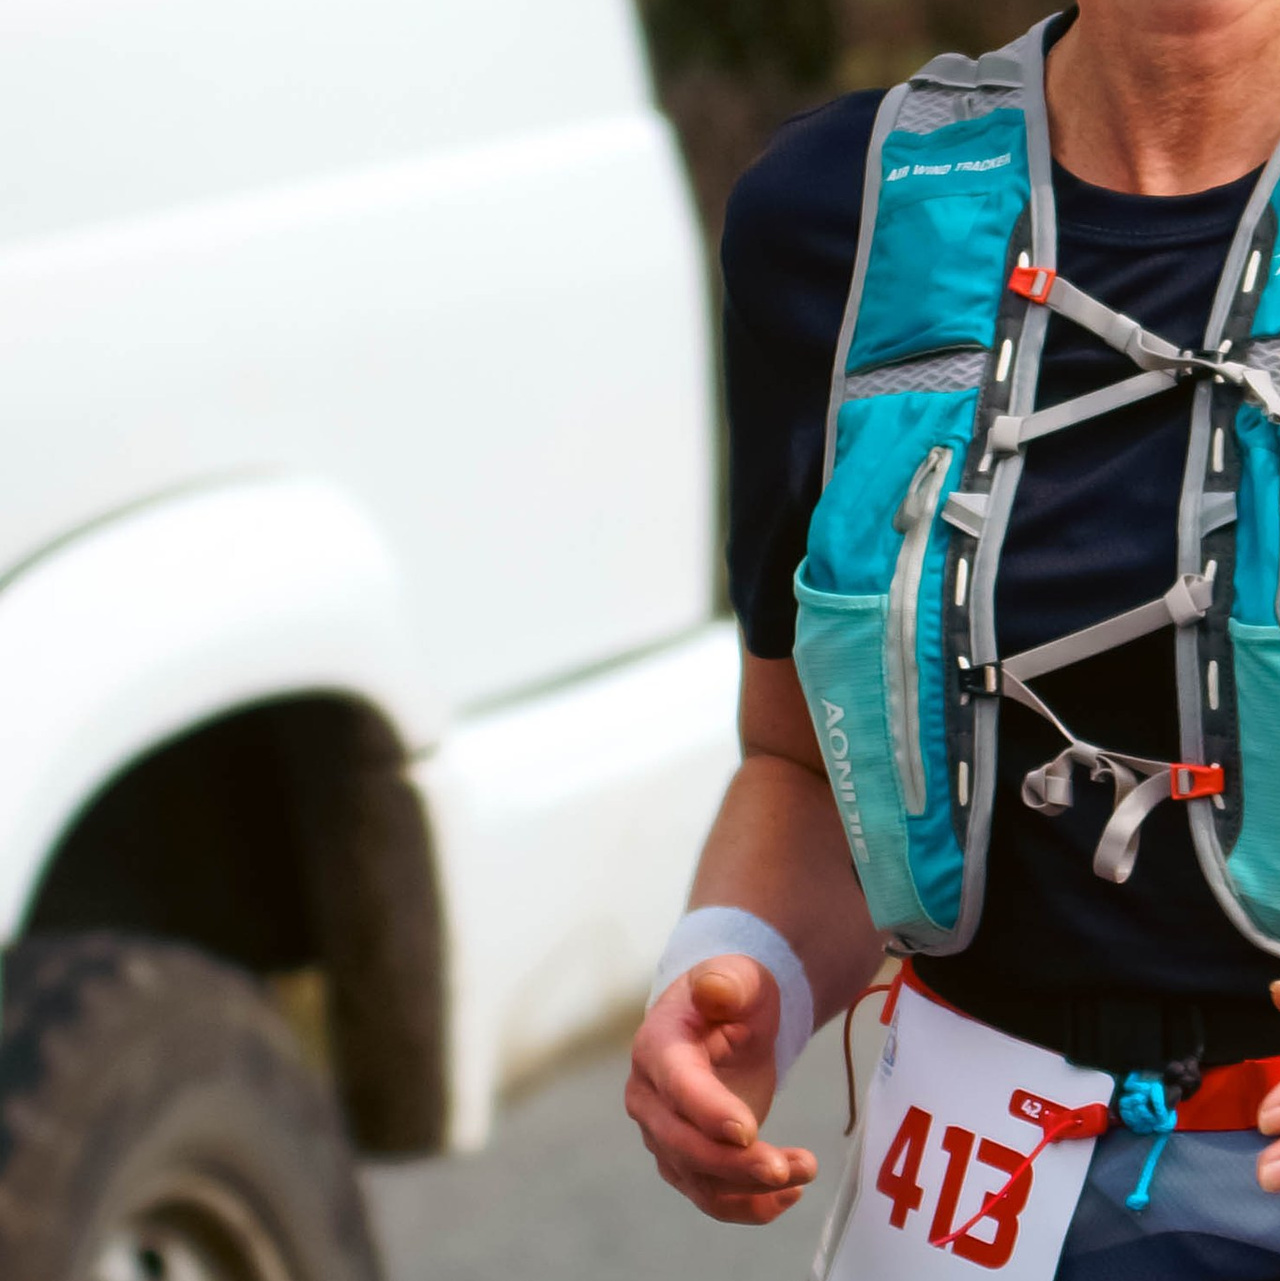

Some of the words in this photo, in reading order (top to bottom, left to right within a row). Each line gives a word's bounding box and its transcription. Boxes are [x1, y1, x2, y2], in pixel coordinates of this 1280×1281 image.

[886, 165, 911, 181] AIR
[913, 164, 952, 176] WIND
[955, 153, 1012, 171] TRACKER
[1021, 1099, 1042, 1119] 42
[876, 1104, 1034, 1270] 413
